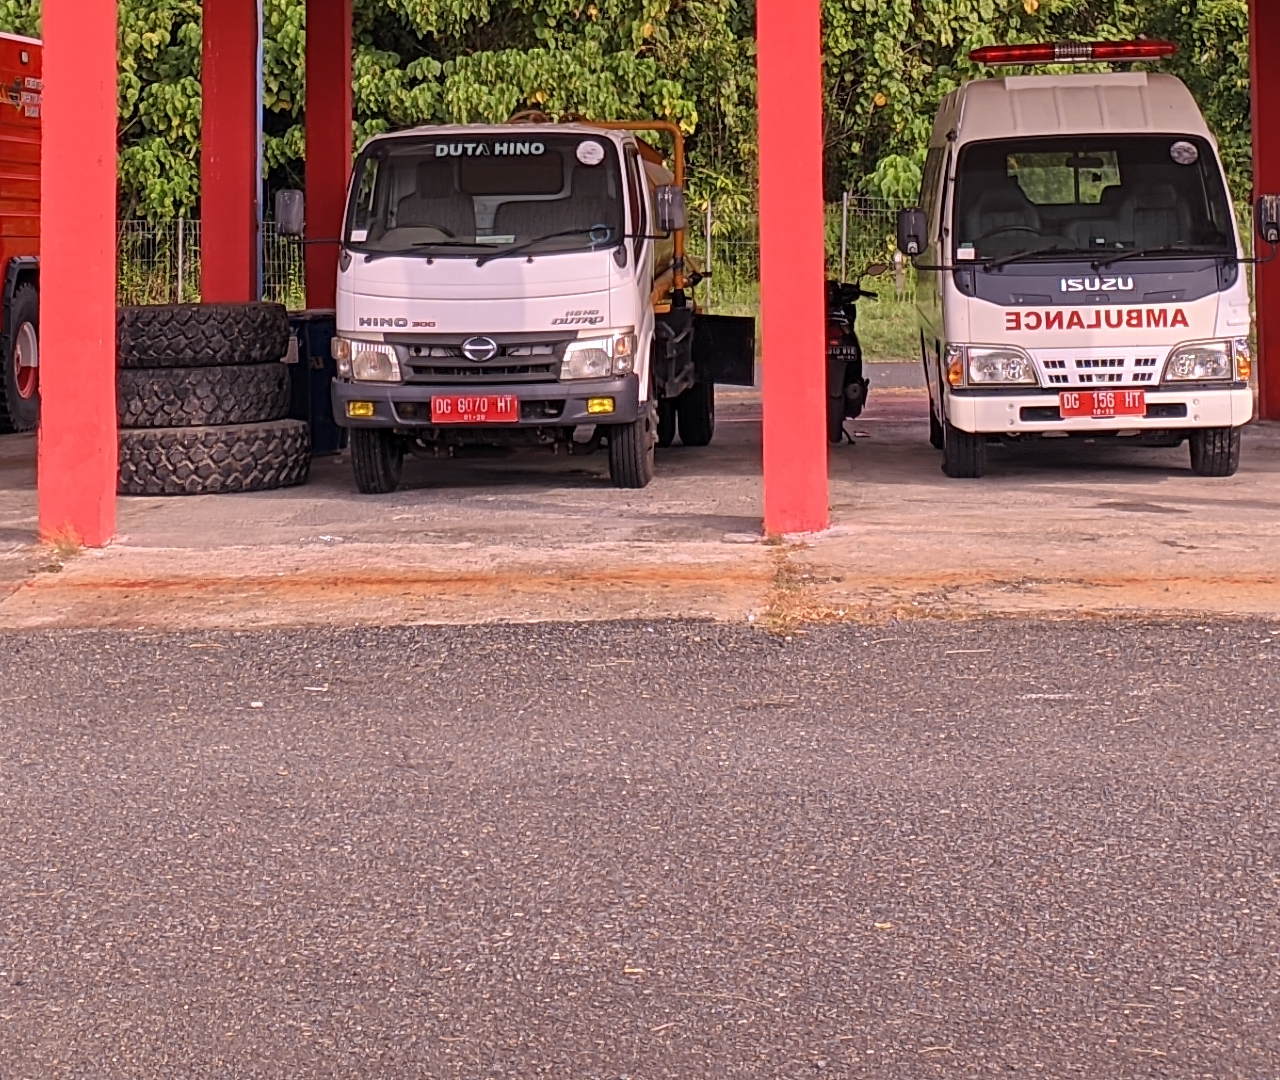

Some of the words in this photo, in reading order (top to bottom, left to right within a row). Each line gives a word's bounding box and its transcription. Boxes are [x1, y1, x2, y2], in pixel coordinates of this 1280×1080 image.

[435, 143, 490, 157] DUTA
[494, 142, 545, 155] HINO
[1060, 276, 1134, 292] ISUZU
[358, 317, 408, 327] HINO
[435, 399, 451, 414] DG
[458, 397, 488, 413] 8070
[497, 397, 511, 413] HT
[1063, 393, 1079, 409] DG
[1093, 392, 1115, 409] 156
[1125, 391, 1140, 408] HT
